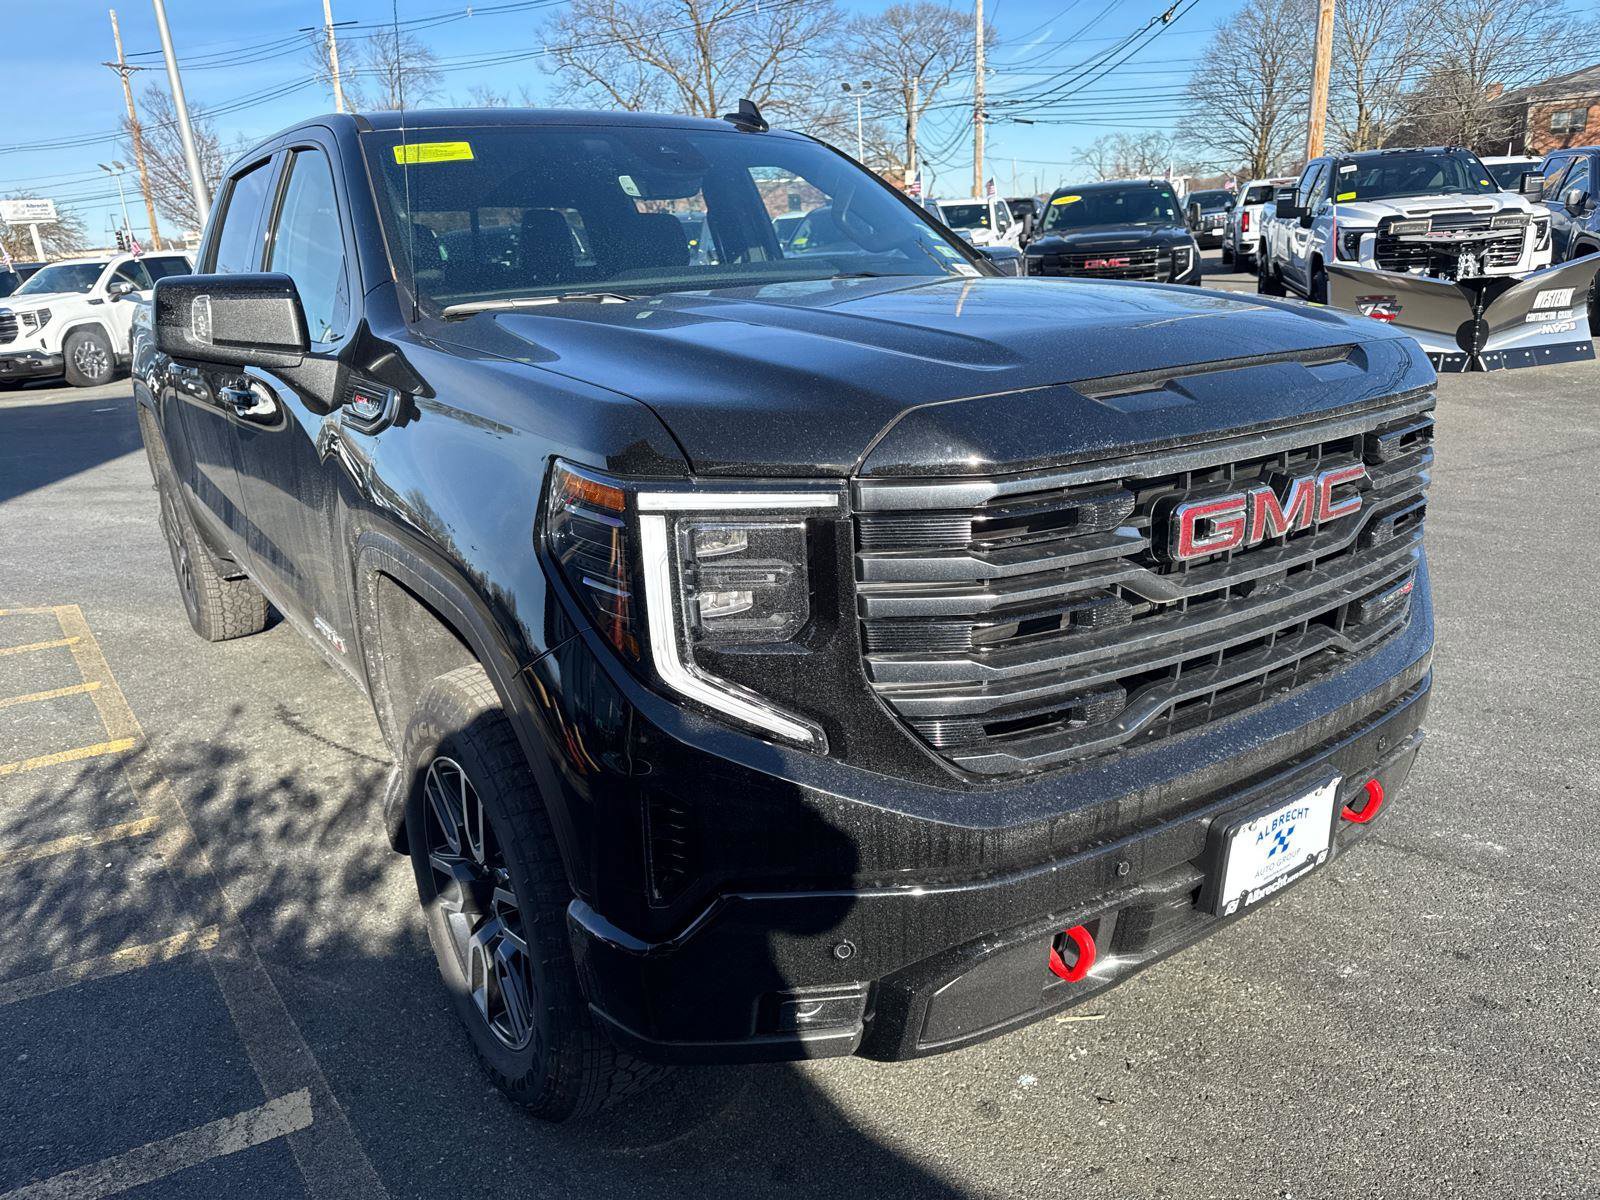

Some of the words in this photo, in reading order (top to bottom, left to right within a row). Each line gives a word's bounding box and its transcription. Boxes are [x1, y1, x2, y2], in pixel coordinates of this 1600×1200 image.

[1084, 257, 1130, 269] GMC
[1533, 287, 1576, 309] WESTERN
[1170, 462, 1366, 562] GMC
[1255, 807, 1310, 845] ALBRECHT
[1255, 862, 1275, 879] AUTO
[1276, 847, 1301, 867] GROUP
[1245, 874, 1288, 907] Albrecht
